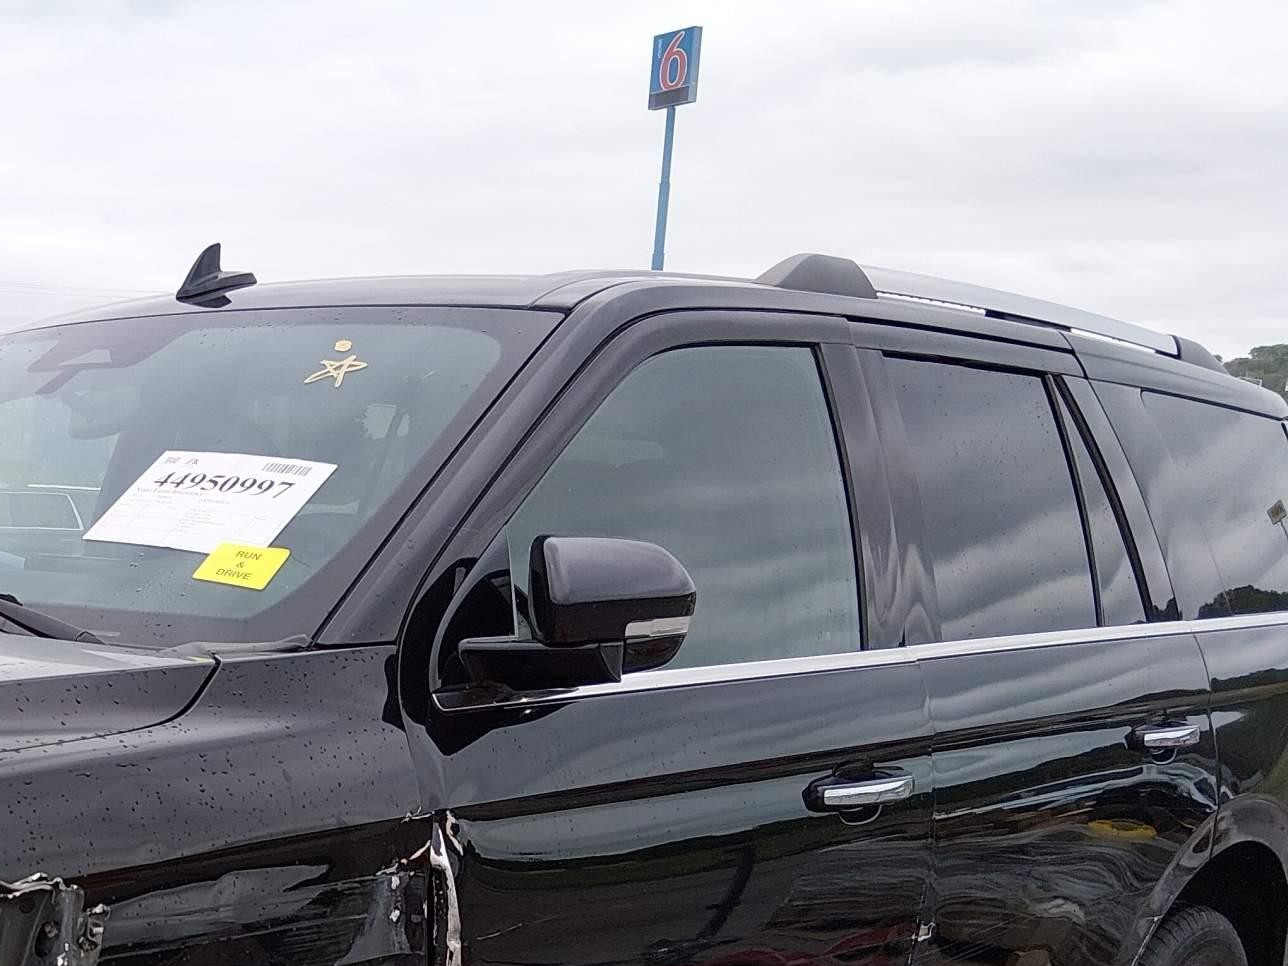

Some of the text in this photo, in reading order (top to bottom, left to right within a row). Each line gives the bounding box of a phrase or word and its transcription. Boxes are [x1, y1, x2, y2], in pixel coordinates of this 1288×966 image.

[659, 31, 687, 91] 6
[153, 471, 296, 499] 44950997
[235, 550, 263, 561] RUN
[235, 561, 245, 569] &
[215, 568, 254, 580] DRIVE
